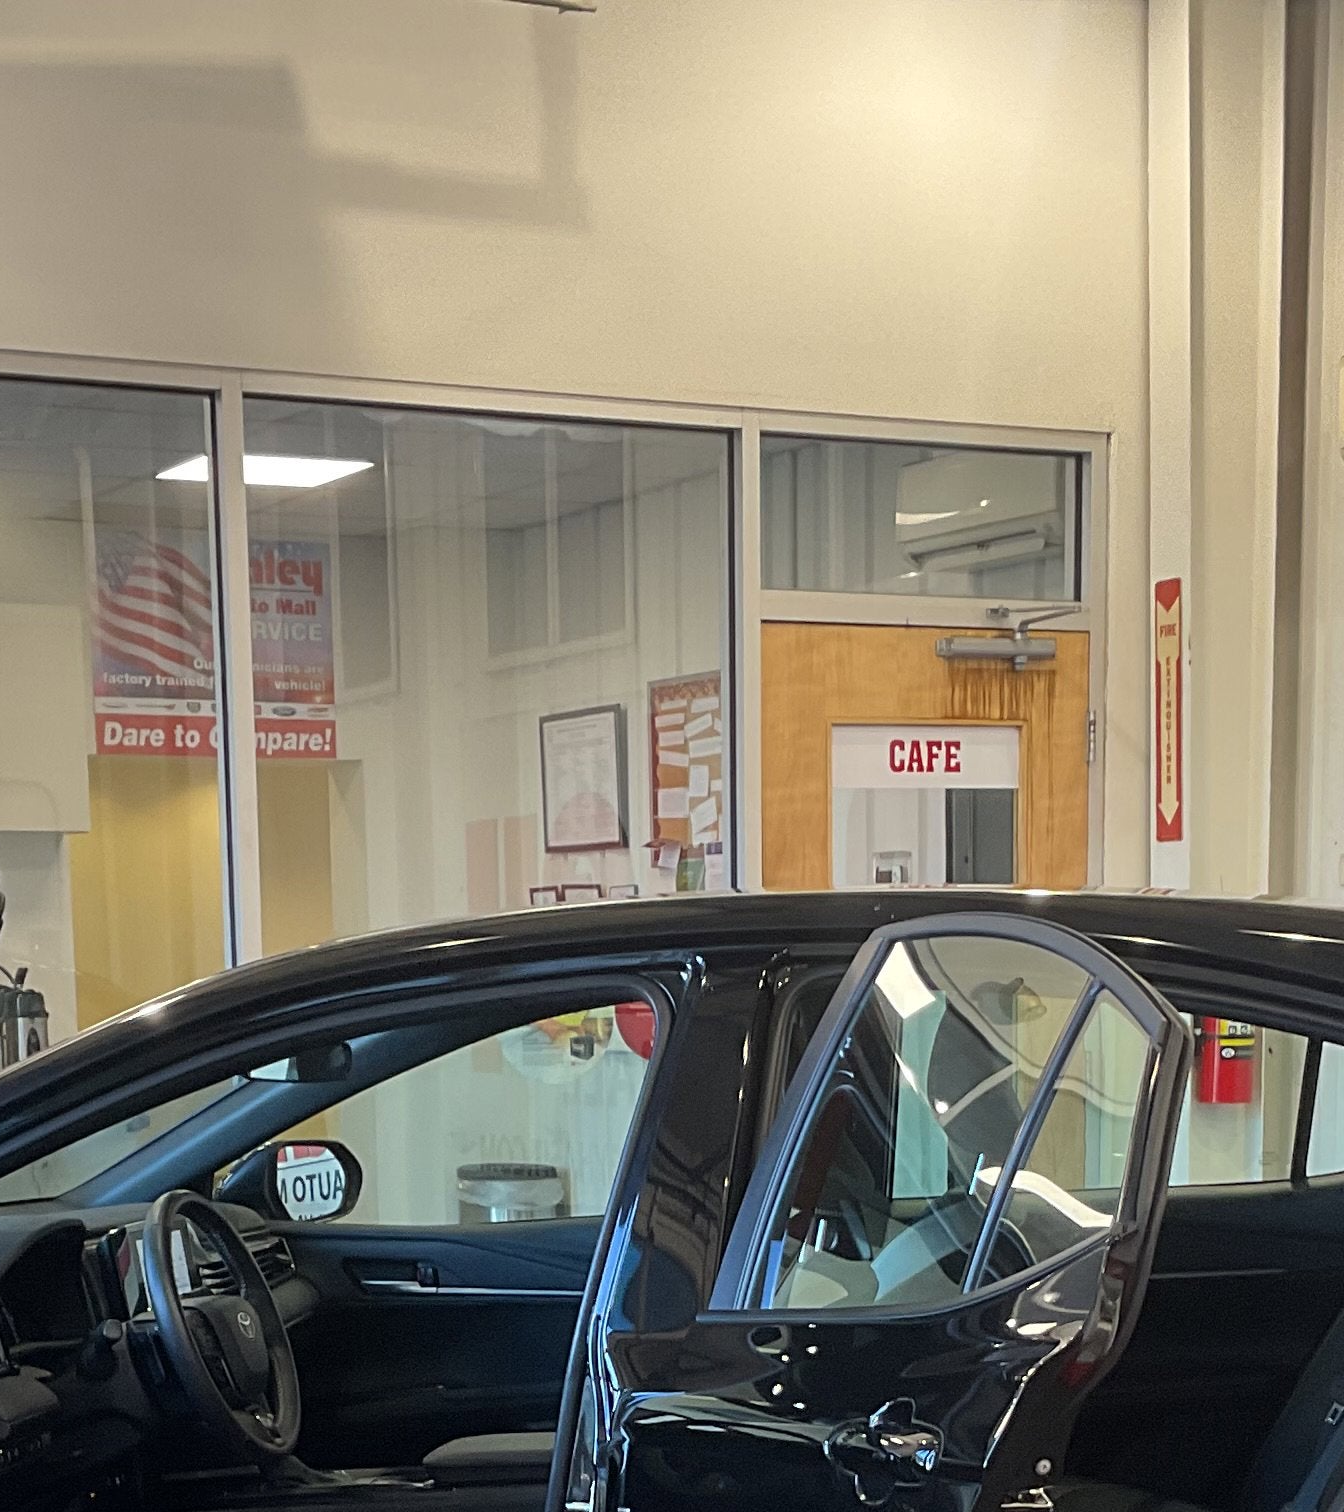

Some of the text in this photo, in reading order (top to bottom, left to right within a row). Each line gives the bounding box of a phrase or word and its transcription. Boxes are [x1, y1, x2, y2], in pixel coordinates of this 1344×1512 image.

[276, 599, 317, 616] Mall
[253, 621, 323, 641] RVICE
[1159, 623, 1177, 638] FIRE
[103, 672, 151, 688] factory
[103, 721, 165, 746] Dare
[174, 724, 201, 748] to
[889, 740, 962, 773] CAFE
